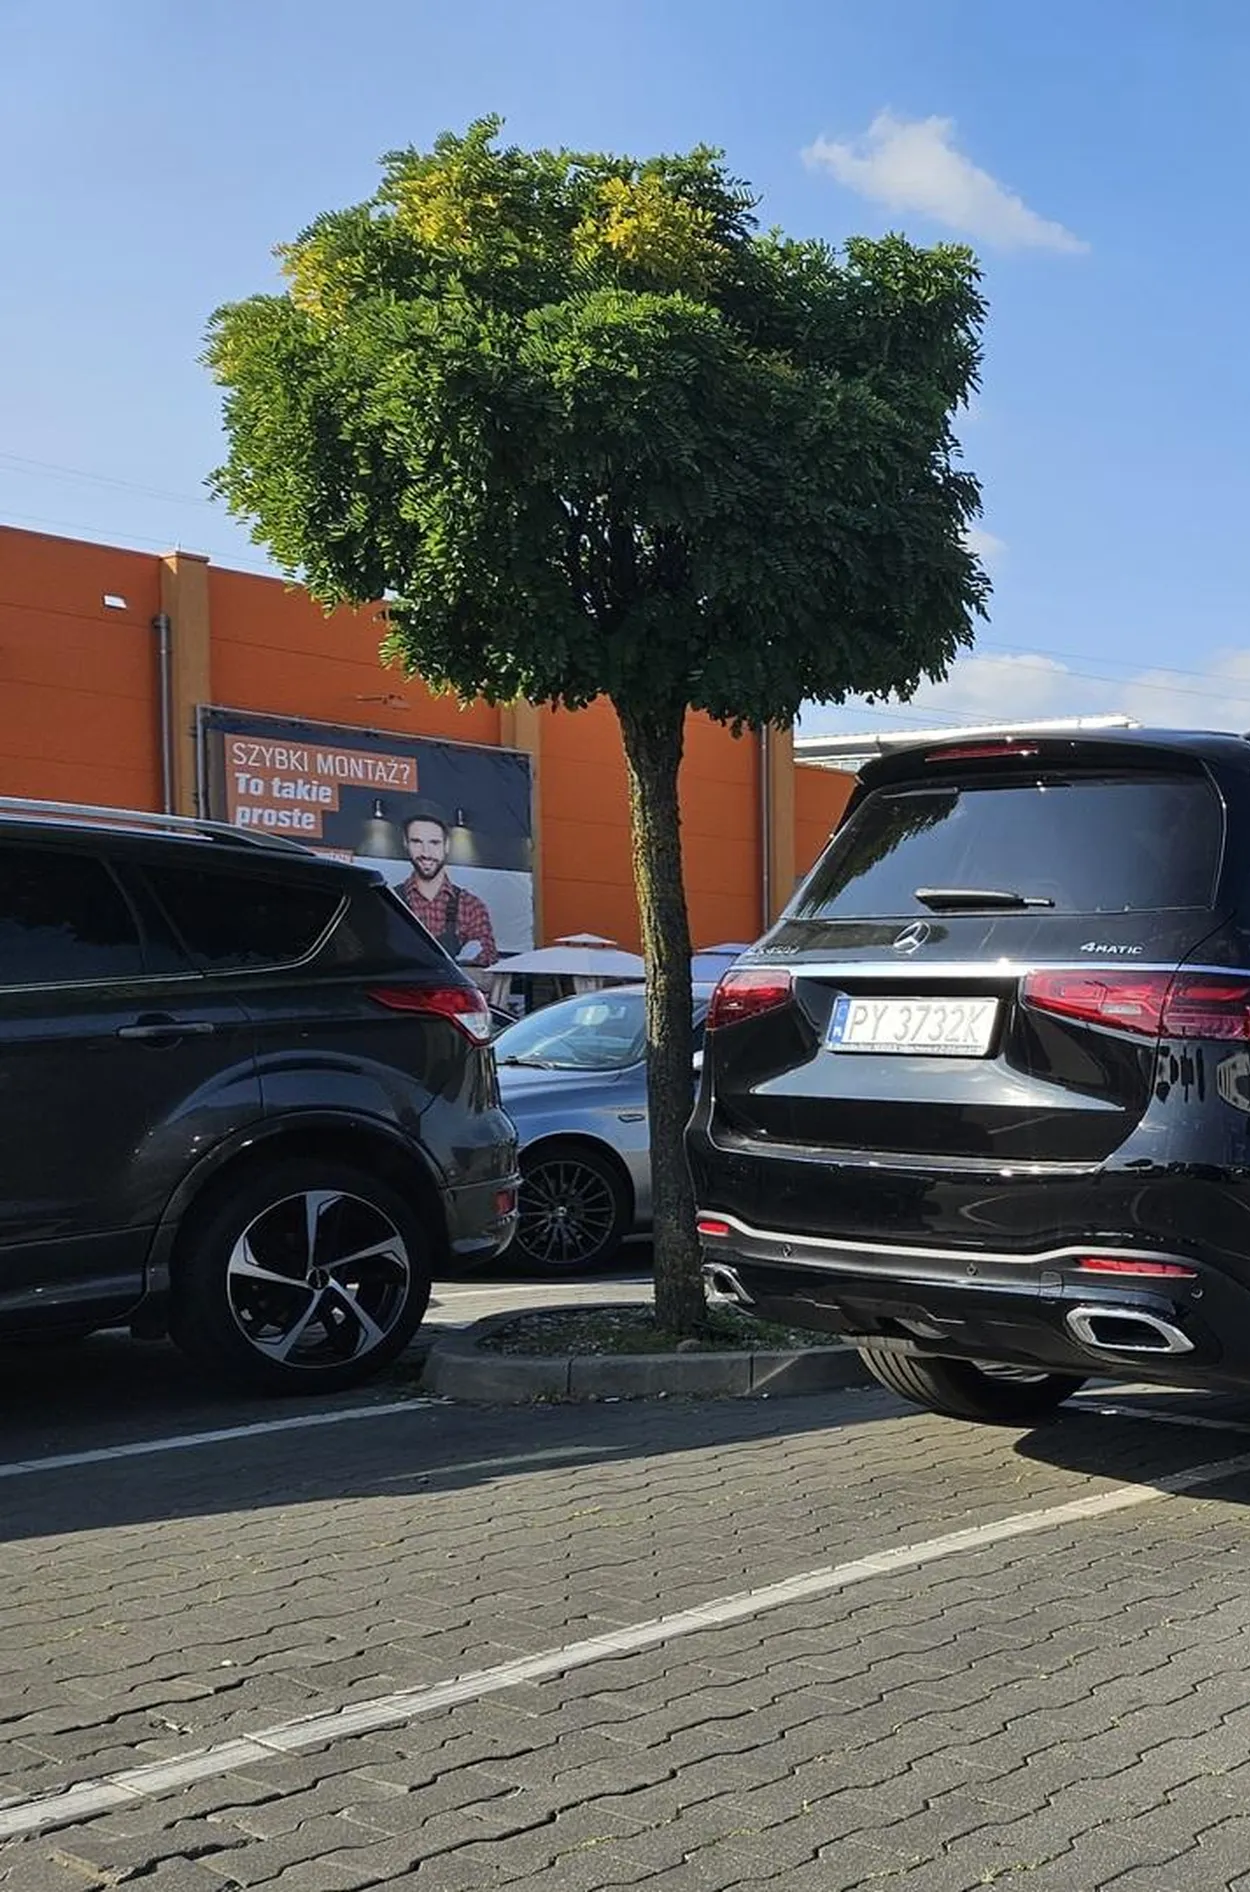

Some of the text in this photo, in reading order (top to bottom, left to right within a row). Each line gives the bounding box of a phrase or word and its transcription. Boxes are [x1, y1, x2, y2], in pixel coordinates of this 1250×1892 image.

[232, 741, 411, 786] SZYBKI MONTAŻ?
[234, 772, 333, 804] To takie
[235, 804, 316, 831] proste
[1079, 941, 1143, 955] 4MATIC
[847, 1004, 990, 1043] PY 3732K
